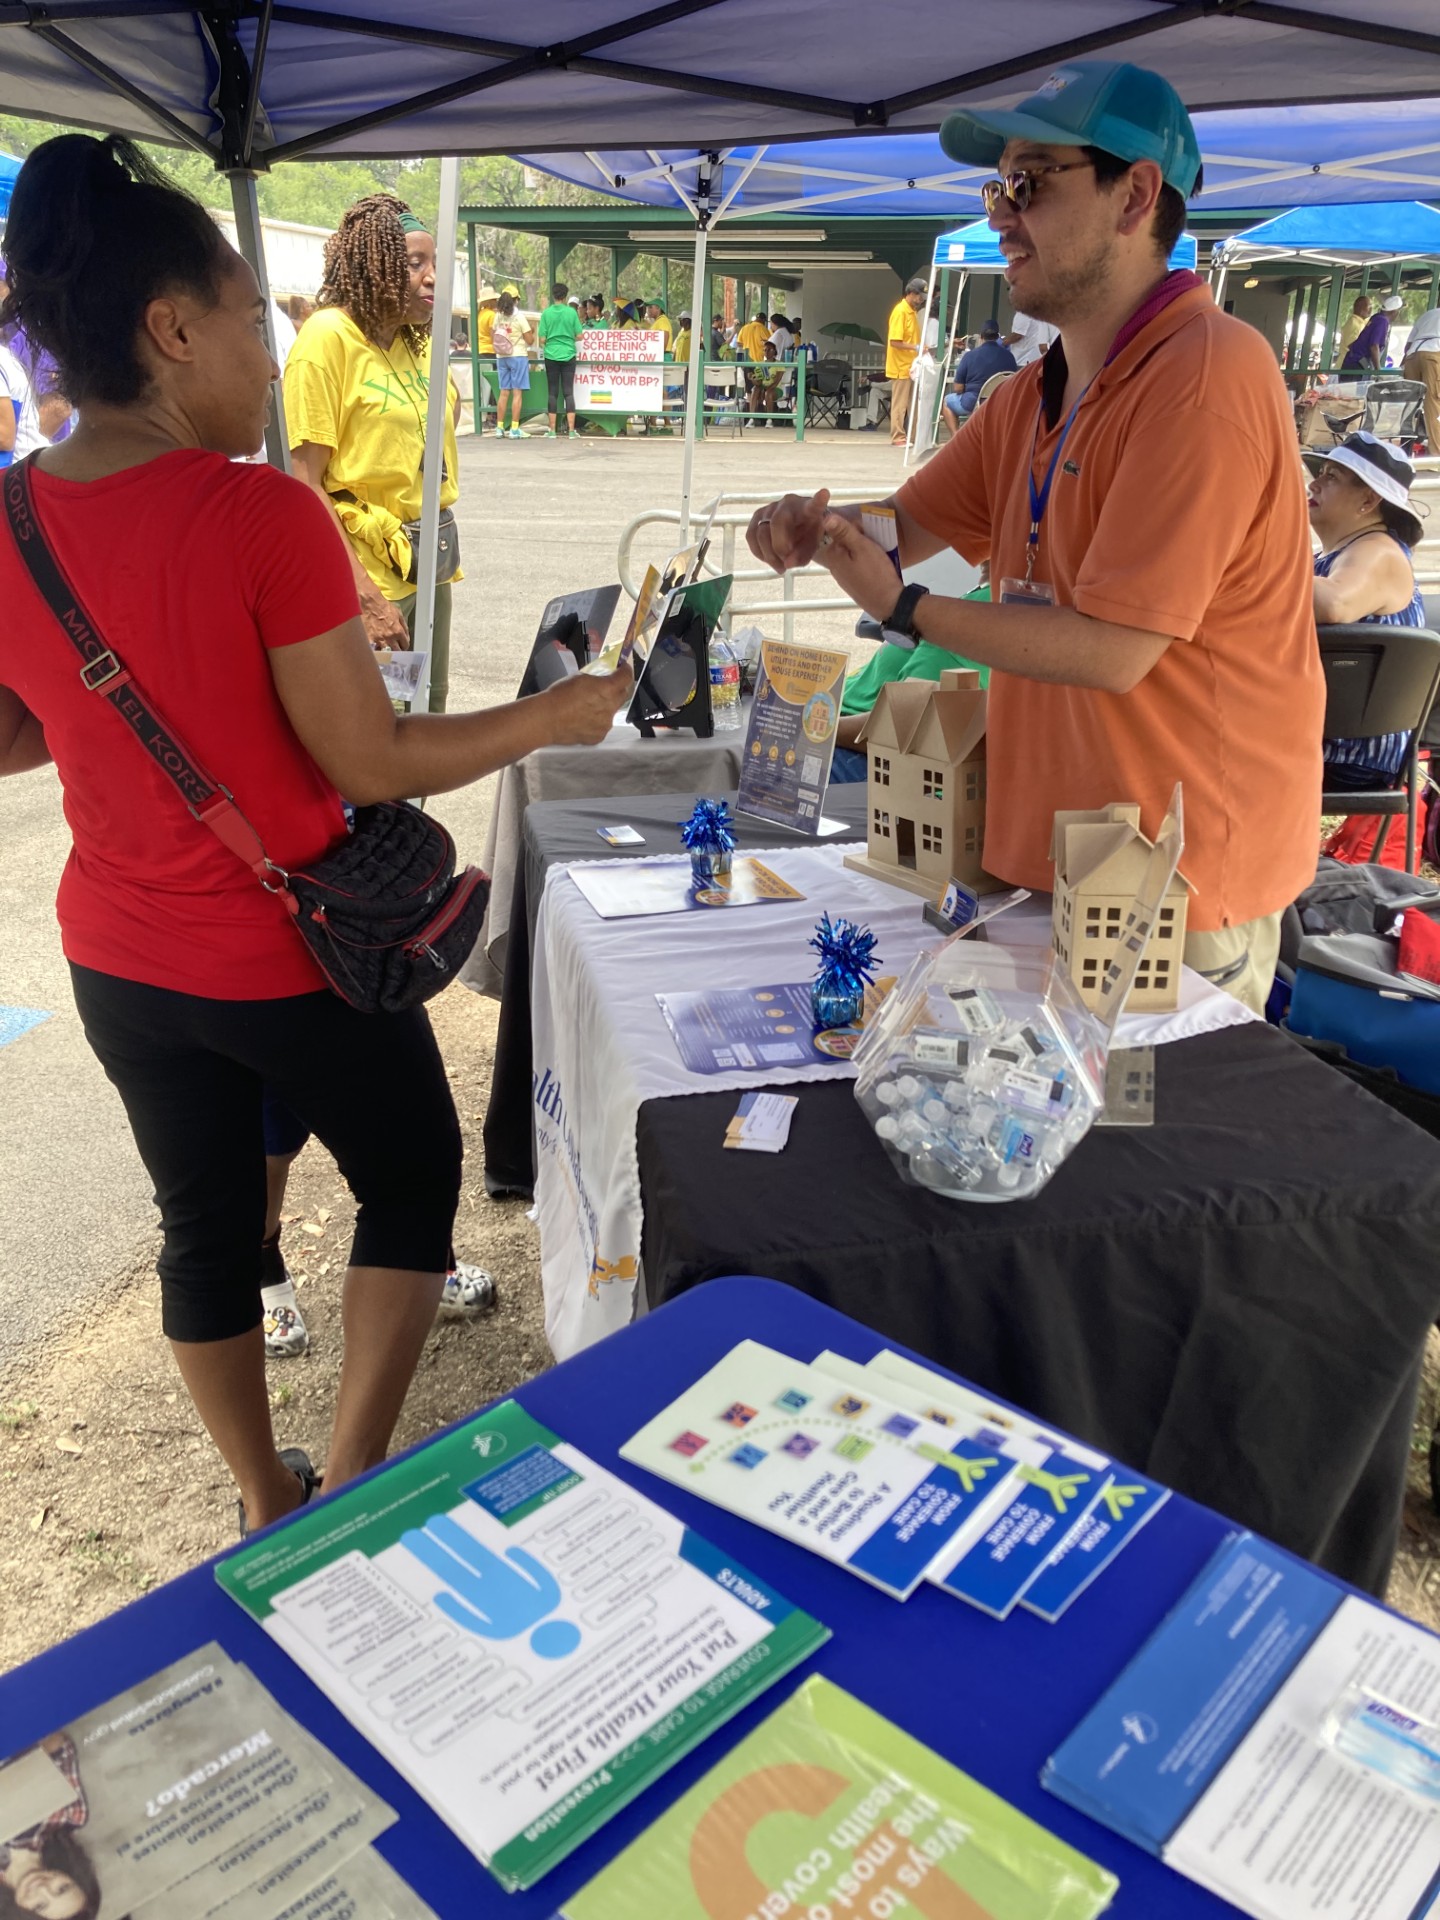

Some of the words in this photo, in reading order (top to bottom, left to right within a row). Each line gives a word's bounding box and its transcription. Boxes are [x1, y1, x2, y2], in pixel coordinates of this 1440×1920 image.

[582, 341, 647, 351] SCREENING
[606, 331, 660, 341] PRESSURE
[609, 376, 638, 386] YOUR
[638, 377, 660, 387] BP?
[8, 470, 35, 543] KORS
[798, 660, 811, 670] AND
[812, 662, 833, 673] OTHER
[800, 649, 818, 661] HOME
[771, 665, 792, 677] HOUSE
[792, 669, 826, 683] EXPENSES?
[150, 732, 211, 801] KORS
[768, 1491, 794, 1512] You
[784, 1471, 836, 1520] Healthier
[829, 1471, 859, 1497] Care
[847, 1486, 865, 1501] to
[877, 1481, 892, 1493] A
[917, 1482, 937, 1500] TO
[798, 1515, 811, 1526] a
[807, 1496, 831, 1519] and
[815, 1499, 854, 1535] Better
[829, 1491, 884, 1542] Roadmap
[891, 1496, 922, 1527] CARE
[895, 1488, 949, 1543] COVERAGE
[930, 1492, 963, 1526] FROM
[1009, 1501, 1029, 1519] TO
[984, 1516, 1015, 1546] CARE
[990, 1507, 1042, 1563] COVERAGE
[1024, 1513, 1056, 1546] FROM
[1078, 1520, 1111, 1552] FROM
[716, 1567, 771, 1610] ADULTS
[696, 1631, 738, 1660] Put
[649, 1657, 700, 1700] Your
[700, 1644, 771, 1699] COVERAGE
[582, 1691, 650, 1750] Health
[679, 1694, 709, 1718] TO
[646, 1709, 687, 1744] CARE
[141, 1726, 274, 1819] Mercado?
[250, 1756, 292, 1791] saber
[536, 1746, 587, 1791] First
[224, 1783, 250, 1805] los
[523, 1770, 613, 1843] Prevention
[132, 1811, 179, 1846] sobre
[185, 1792, 262, 1846] necesitan
[828, 1774, 908, 1851] health
[891, 1792, 941, 1838] the
[130, 1799, 225, 1863] estudiantes
[216, 1818, 294, 1874] necesitan
[255, 1836, 330, 1896] necesitan
[896, 1816, 975, 1889] Ways
[745, 1847, 833, 1920] cover
[826, 1832, 897, 1909] most
[869, 1885, 908, 1919] to
